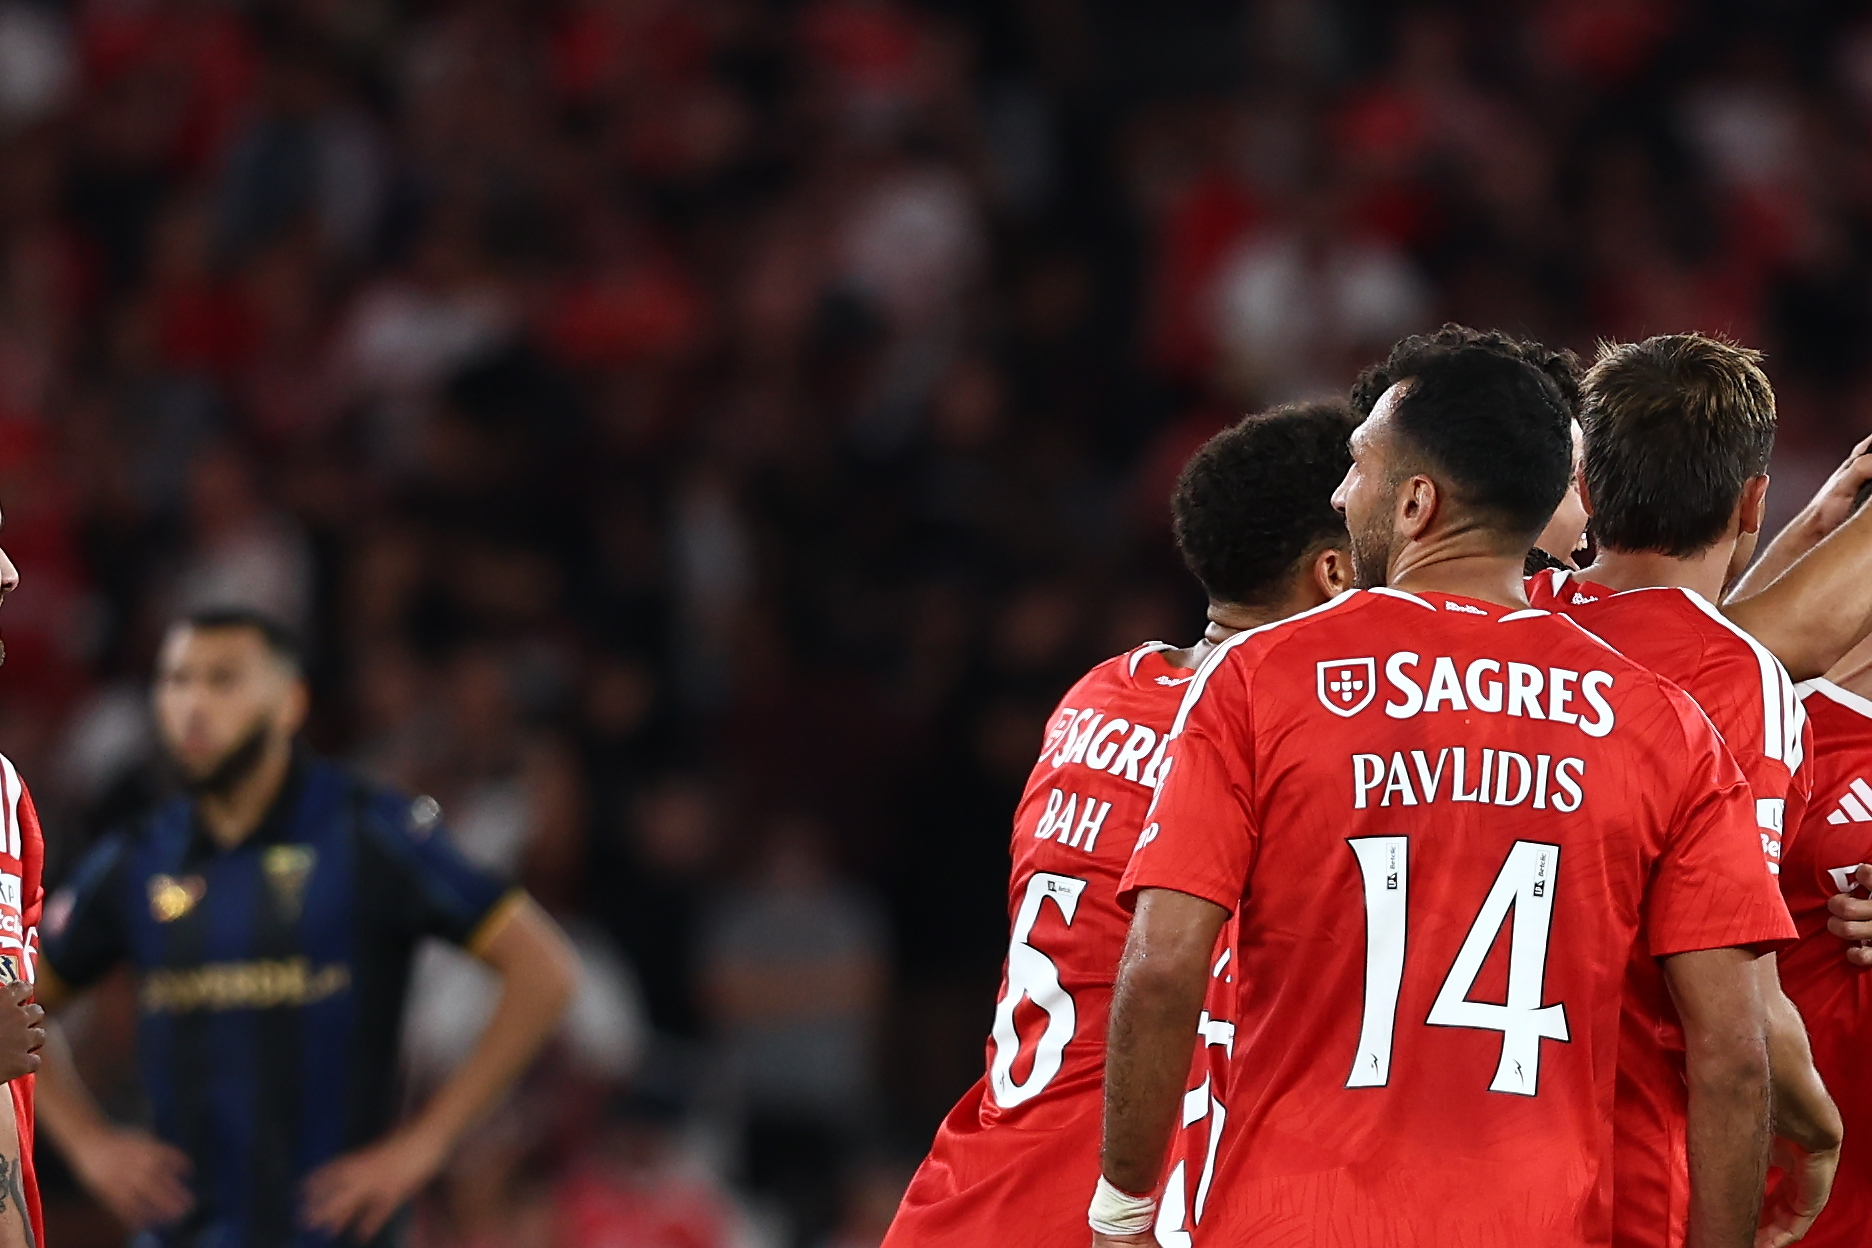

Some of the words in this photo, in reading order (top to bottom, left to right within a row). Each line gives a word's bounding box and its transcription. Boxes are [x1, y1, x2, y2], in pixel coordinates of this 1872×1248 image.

[1384, 650, 1616, 738] SAGRES
[1034, 787, 1113, 853] BAH
[1351, 746, 1586, 813] PAVLIDIS
[990, 871, 1088, 1109] 6
[1343, 834, 1573, 1098] 14
